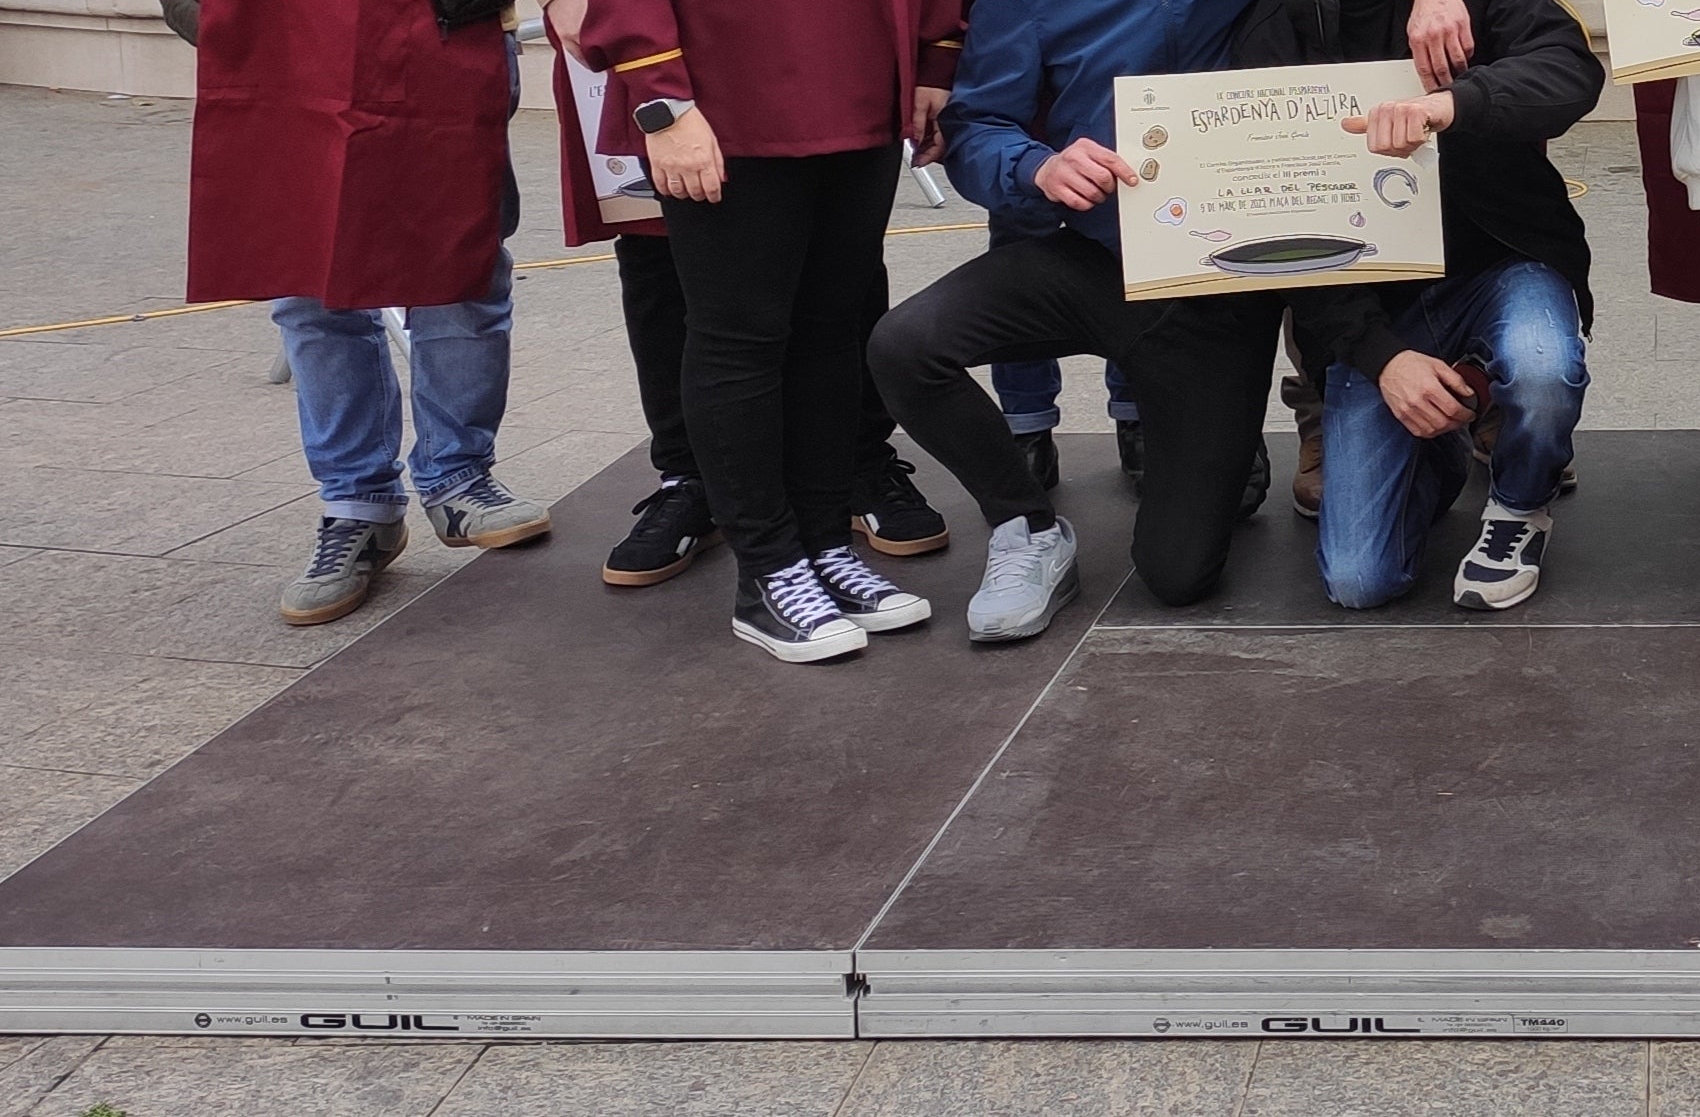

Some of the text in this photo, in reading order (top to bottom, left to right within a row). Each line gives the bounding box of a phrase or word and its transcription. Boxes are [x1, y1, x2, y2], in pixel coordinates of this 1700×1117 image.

[1286, 93, 1363, 122] D'ALZIRA
[1294, 169, 1319, 178] premi
[1218, 189, 1233, 197] LA
[1281, 185, 1299, 193] DEL
[1292, 197, 1303, 206] DEL
[216, 1013, 459, 1030] www.guil.es GUIL
[1175, 1017, 1420, 1033] www.guil.es GUIL
